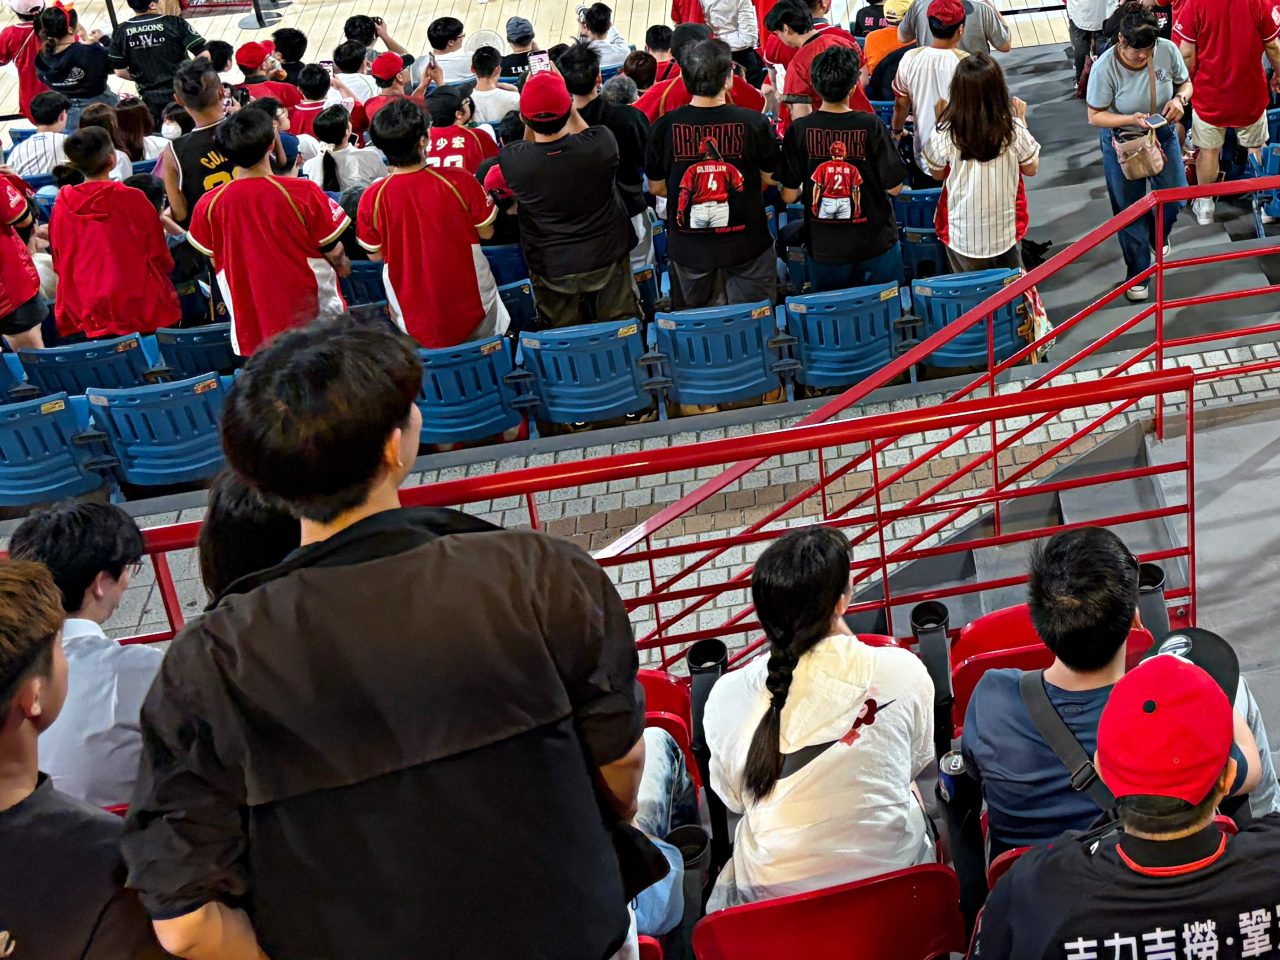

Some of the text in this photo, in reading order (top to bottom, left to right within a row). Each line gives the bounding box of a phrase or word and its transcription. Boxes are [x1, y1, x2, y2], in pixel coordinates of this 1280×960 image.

[125, 24, 164, 37] DRAGONS
[707, 173, 718, 191] 4
[833, 174, 843, 190] 2
